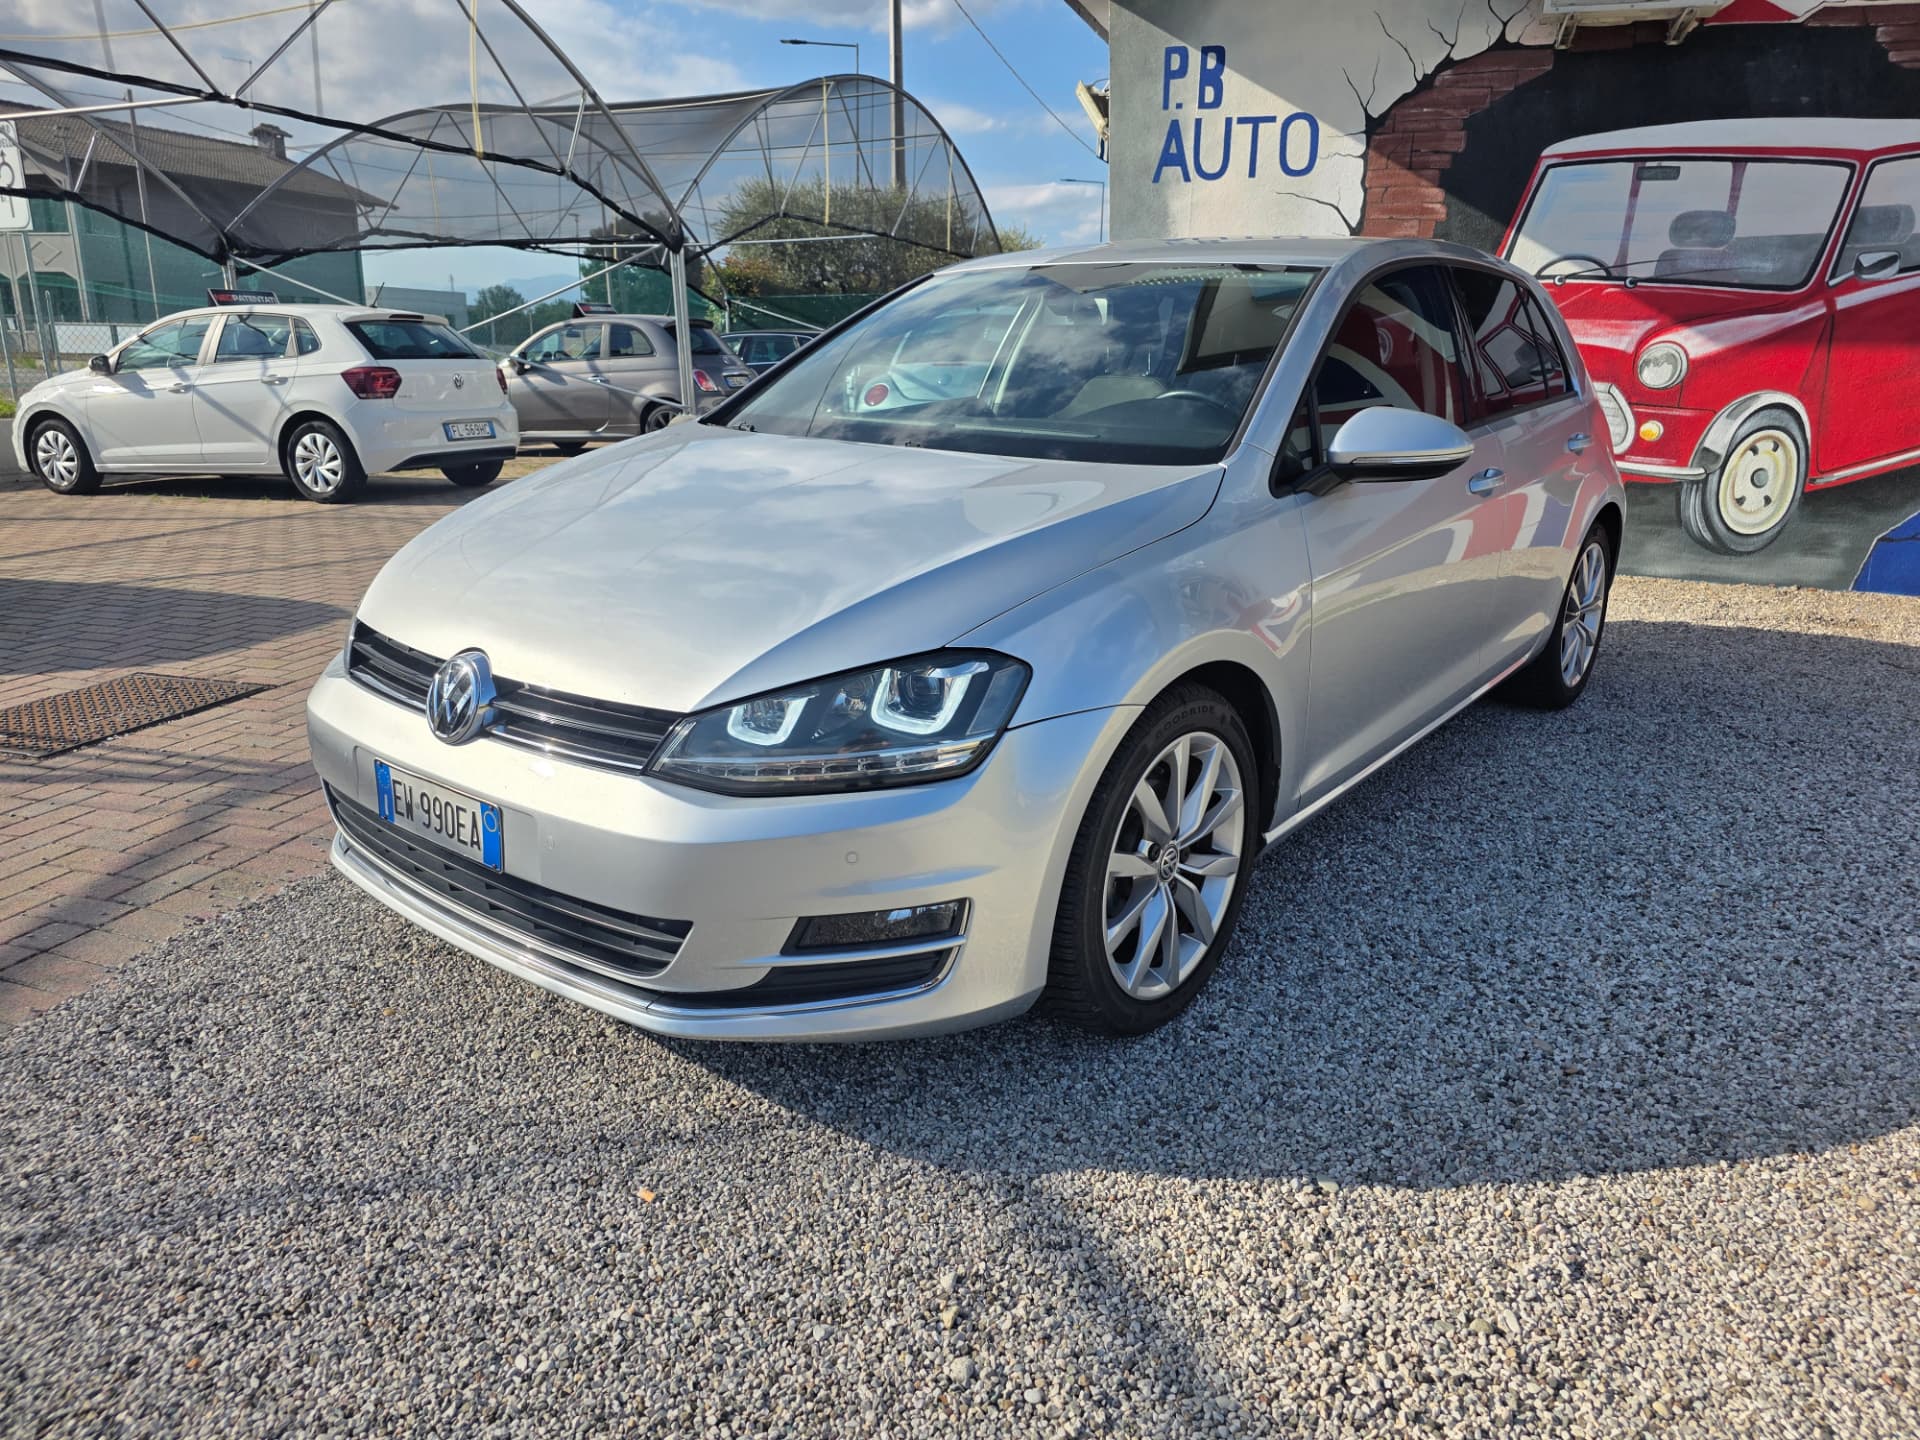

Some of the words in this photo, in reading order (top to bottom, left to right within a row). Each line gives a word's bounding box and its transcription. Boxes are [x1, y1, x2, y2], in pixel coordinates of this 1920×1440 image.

[1152, 112, 1319, 183] AUTO
[391, 778, 414, 822] EW
[419, 791, 481, 851] 990EA
